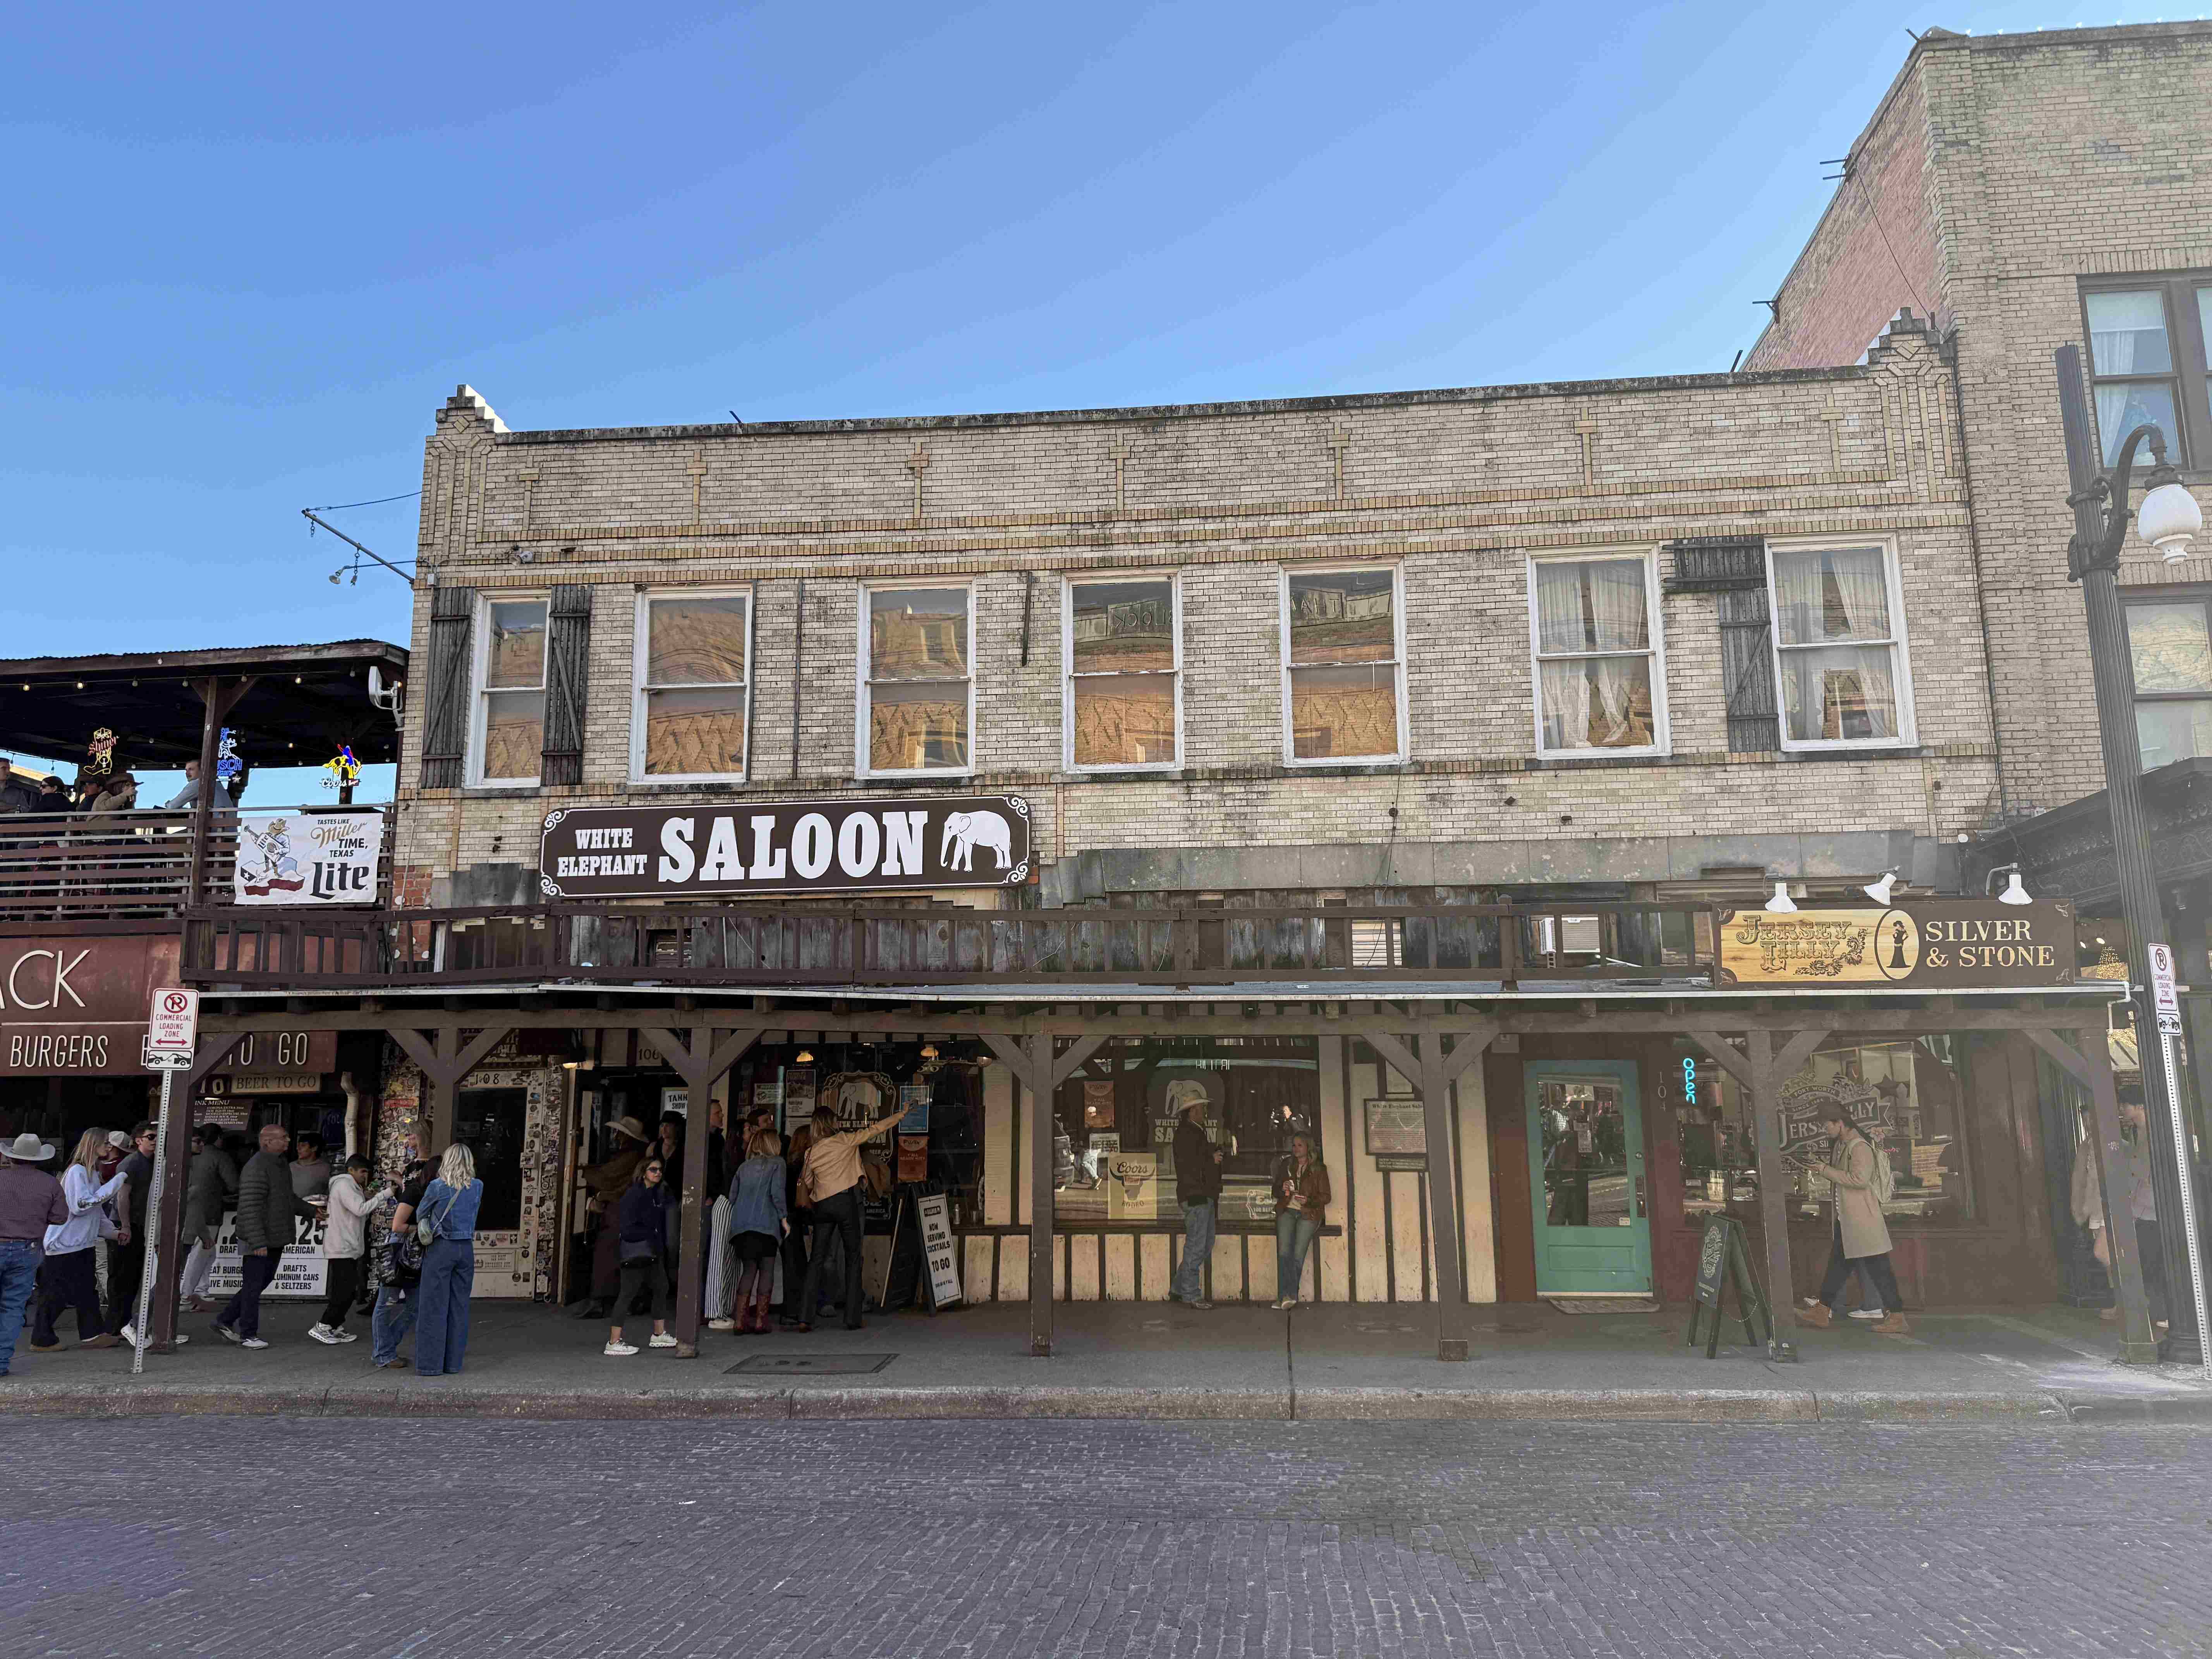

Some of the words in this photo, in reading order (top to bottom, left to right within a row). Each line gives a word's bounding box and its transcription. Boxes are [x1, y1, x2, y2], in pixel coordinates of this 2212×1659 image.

[311, 823, 368, 848] Miller
[338, 838, 368, 849] TIME,
[575, 828, 633, 849] WHITE
[658, 811, 928, 883] SALOON
[557, 854, 647, 877] ELEPHANT
[309, 862, 369, 900] Lite
[1735, 915, 1852, 945] JERSEY
[1925, 920, 2032, 942] SILVER
[1760, 941, 1840, 970] LILLY
[1926, 947, 1949, 967] &
[1958, 946, 2054, 967] STONE
[0, 950, 90, 1009] CK
[156, 1013, 192, 1022] COMMERCIAL
[10, 1035, 108, 1068] BURGERS
[278, 1032, 308, 1065] GO
[236, 1077, 270, 1089] BEER
[275, 1076, 293, 1088] TO
[298, 1075, 316, 1088] GO
[475, 1073, 500, 1084] 108
[1793, 1087, 1809, 1097] FORT
[1812, 1086, 1836, 1094] WORTH
[1117, 1162, 1147, 1174] Coors
[1121, 1200, 1144, 1209] RODEO
[927, 1232, 945, 1242] SERVING
[927, 1241, 950, 1253] COCKTAILS
[932, 1261, 939, 1271] TO
[940, 1257, 950, 1270] GO
